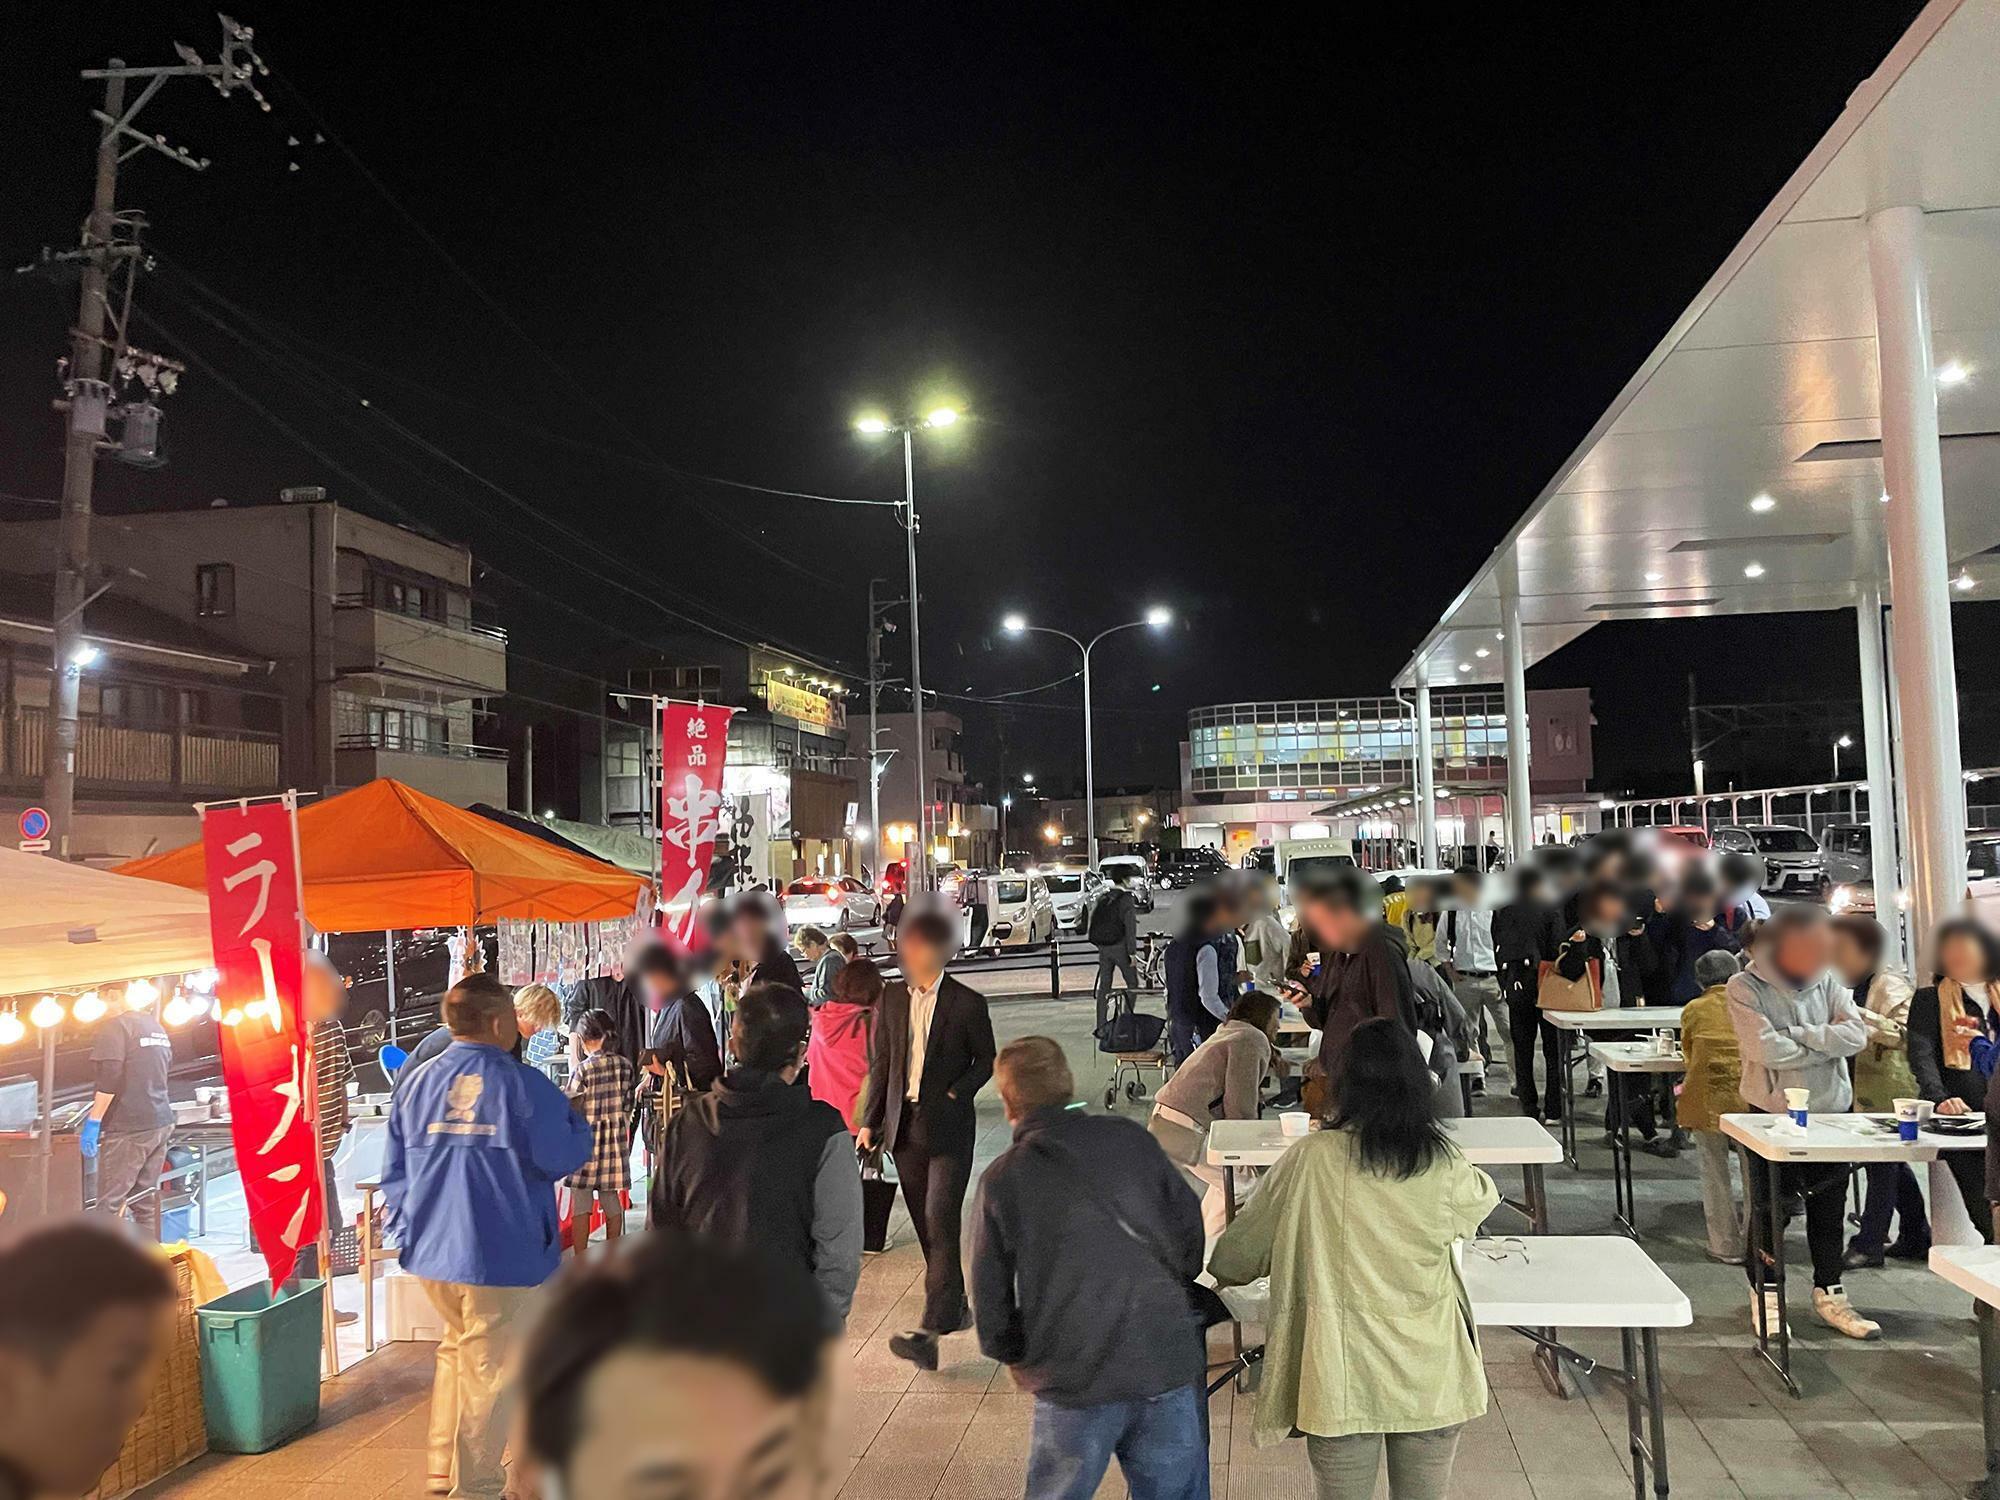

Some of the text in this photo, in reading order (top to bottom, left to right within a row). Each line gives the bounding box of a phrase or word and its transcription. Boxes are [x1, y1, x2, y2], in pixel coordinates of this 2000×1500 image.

[686, 716, 708, 767] 絶品
[223, 832, 310, 1250] ラーメン
